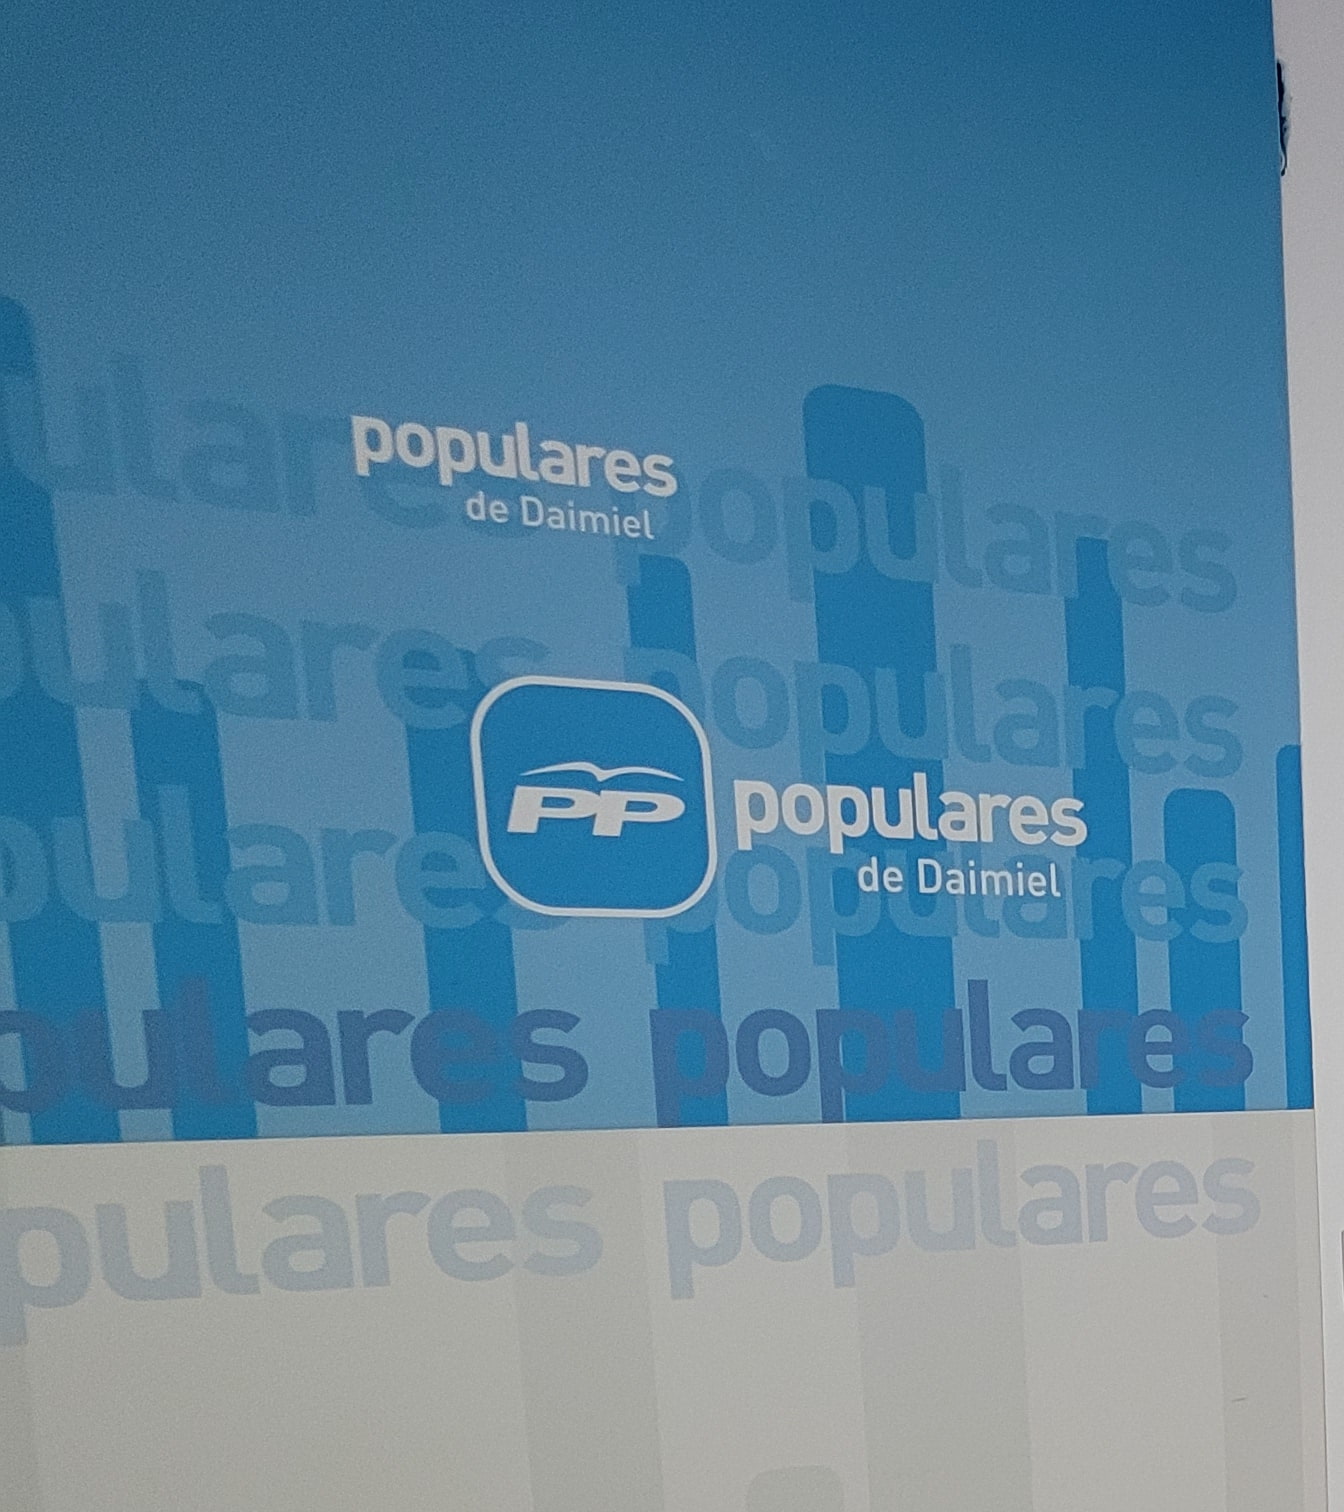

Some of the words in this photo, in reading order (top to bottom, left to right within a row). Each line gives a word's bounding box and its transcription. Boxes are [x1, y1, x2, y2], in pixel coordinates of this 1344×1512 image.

[350, 413, 679, 498] populares
[466, 490, 510, 525] de
[520, 494, 656, 541] Daimiel
[506, 784, 686, 837] PP
[733, 771, 1088, 855] populares
[857, 857, 904, 894] de
[916, 857, 1062, 899] Daimiel
[648, 977, 1255, 1128] populares
[661, 1138, 1263, 1300] populares
